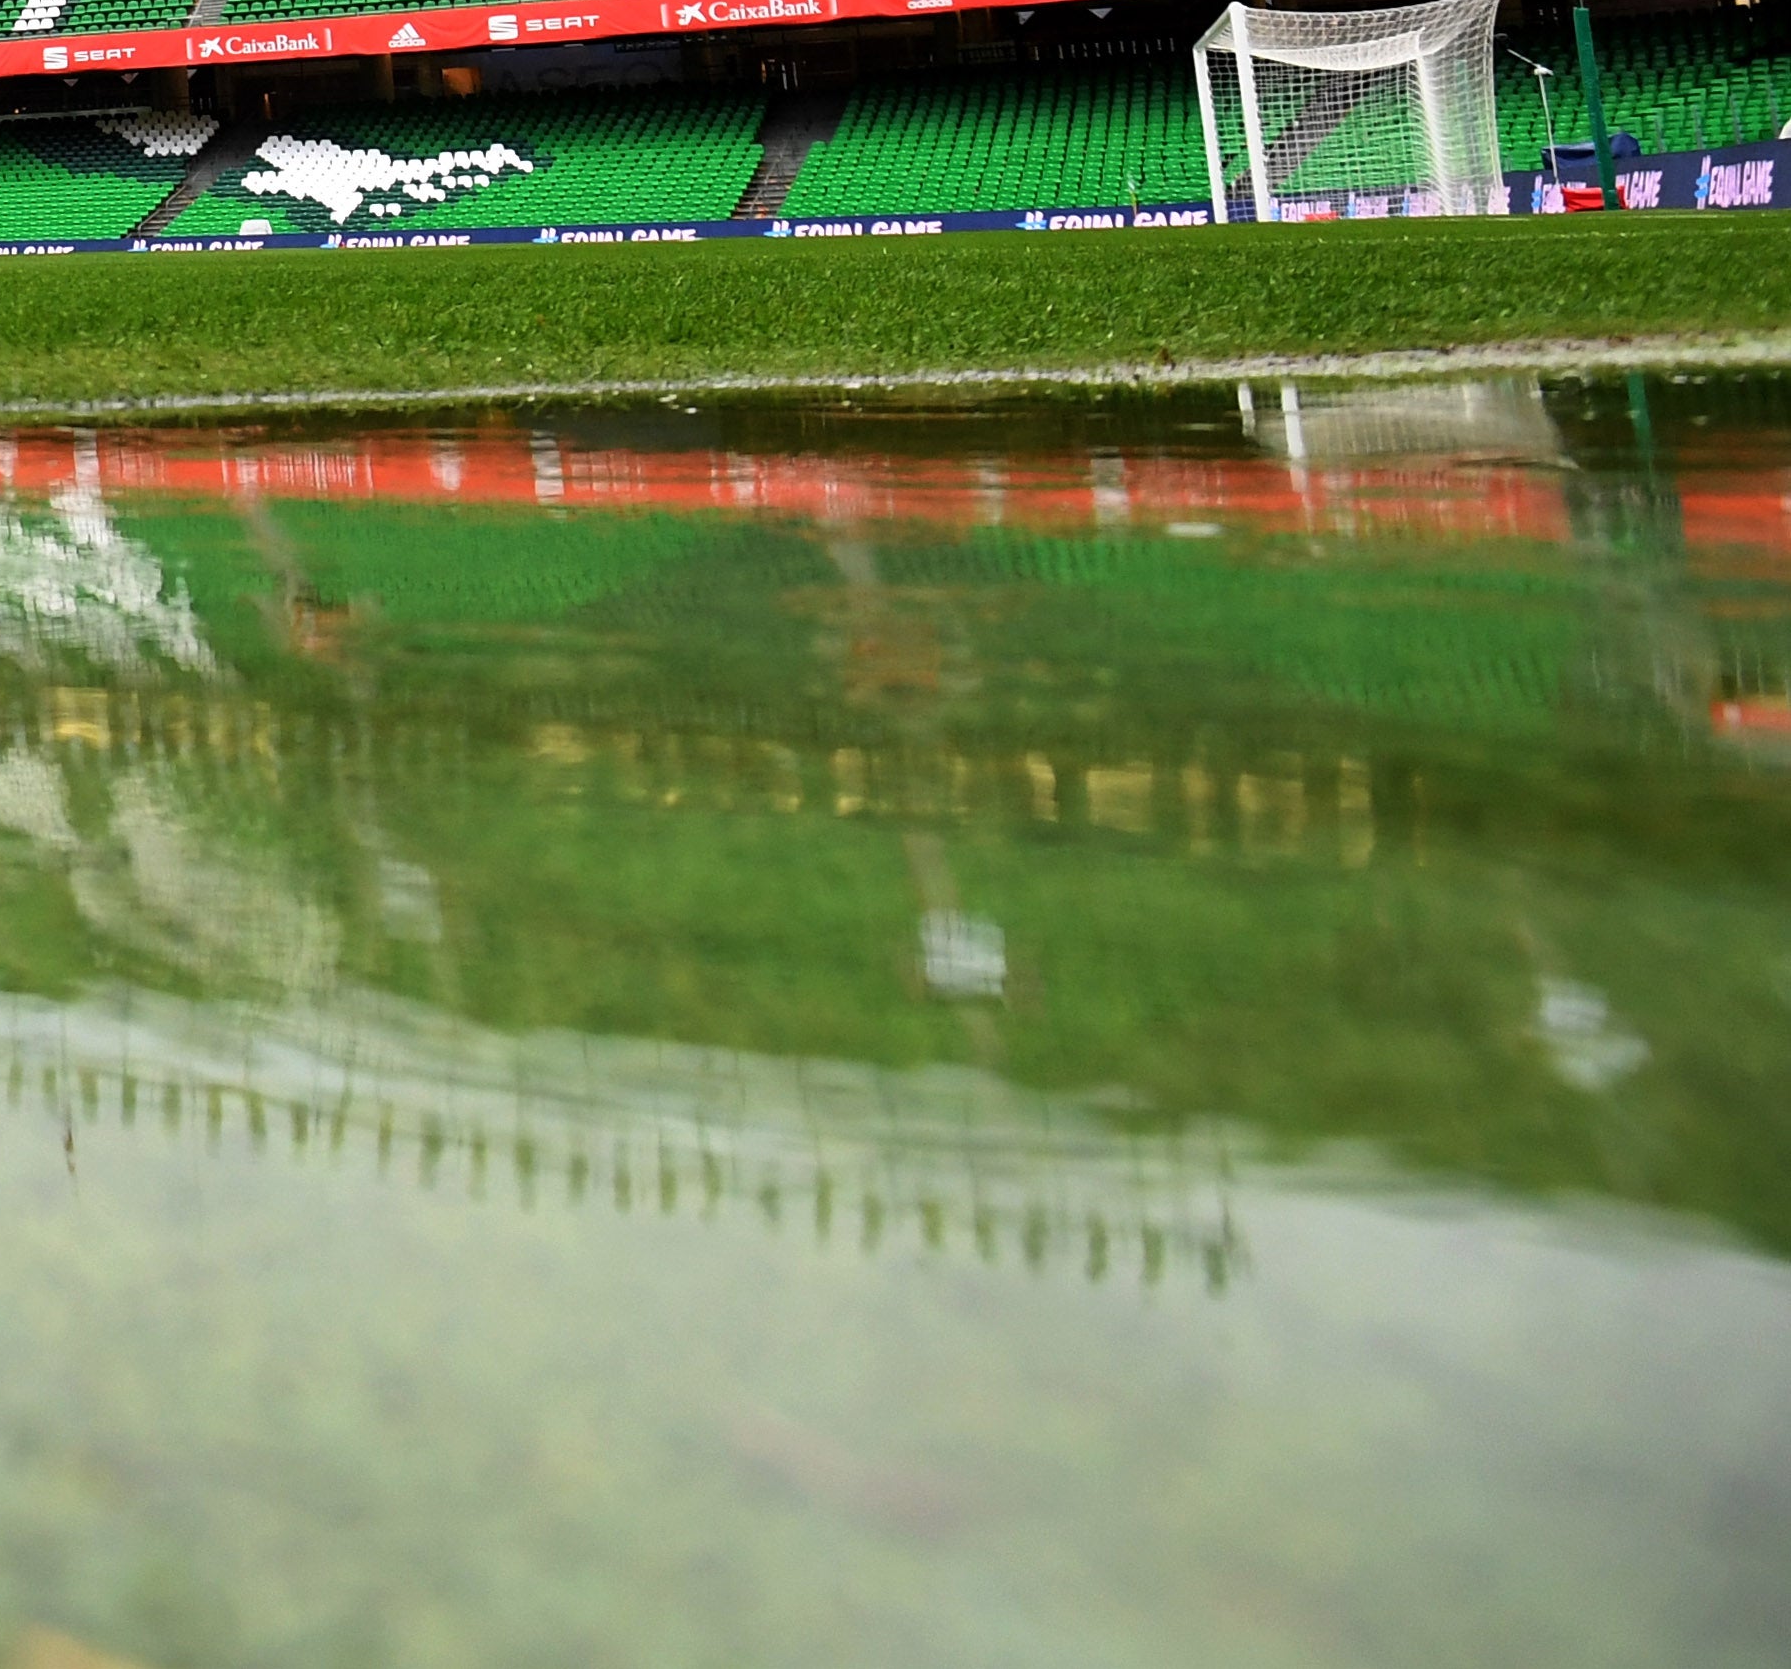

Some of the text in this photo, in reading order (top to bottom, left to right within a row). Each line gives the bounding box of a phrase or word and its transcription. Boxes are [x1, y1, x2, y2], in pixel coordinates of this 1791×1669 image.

[525, 14, 600, 32] SEAT
[225, 32, 320, 55] CaixaBank
[73, 47, 136, 62] SEAT
